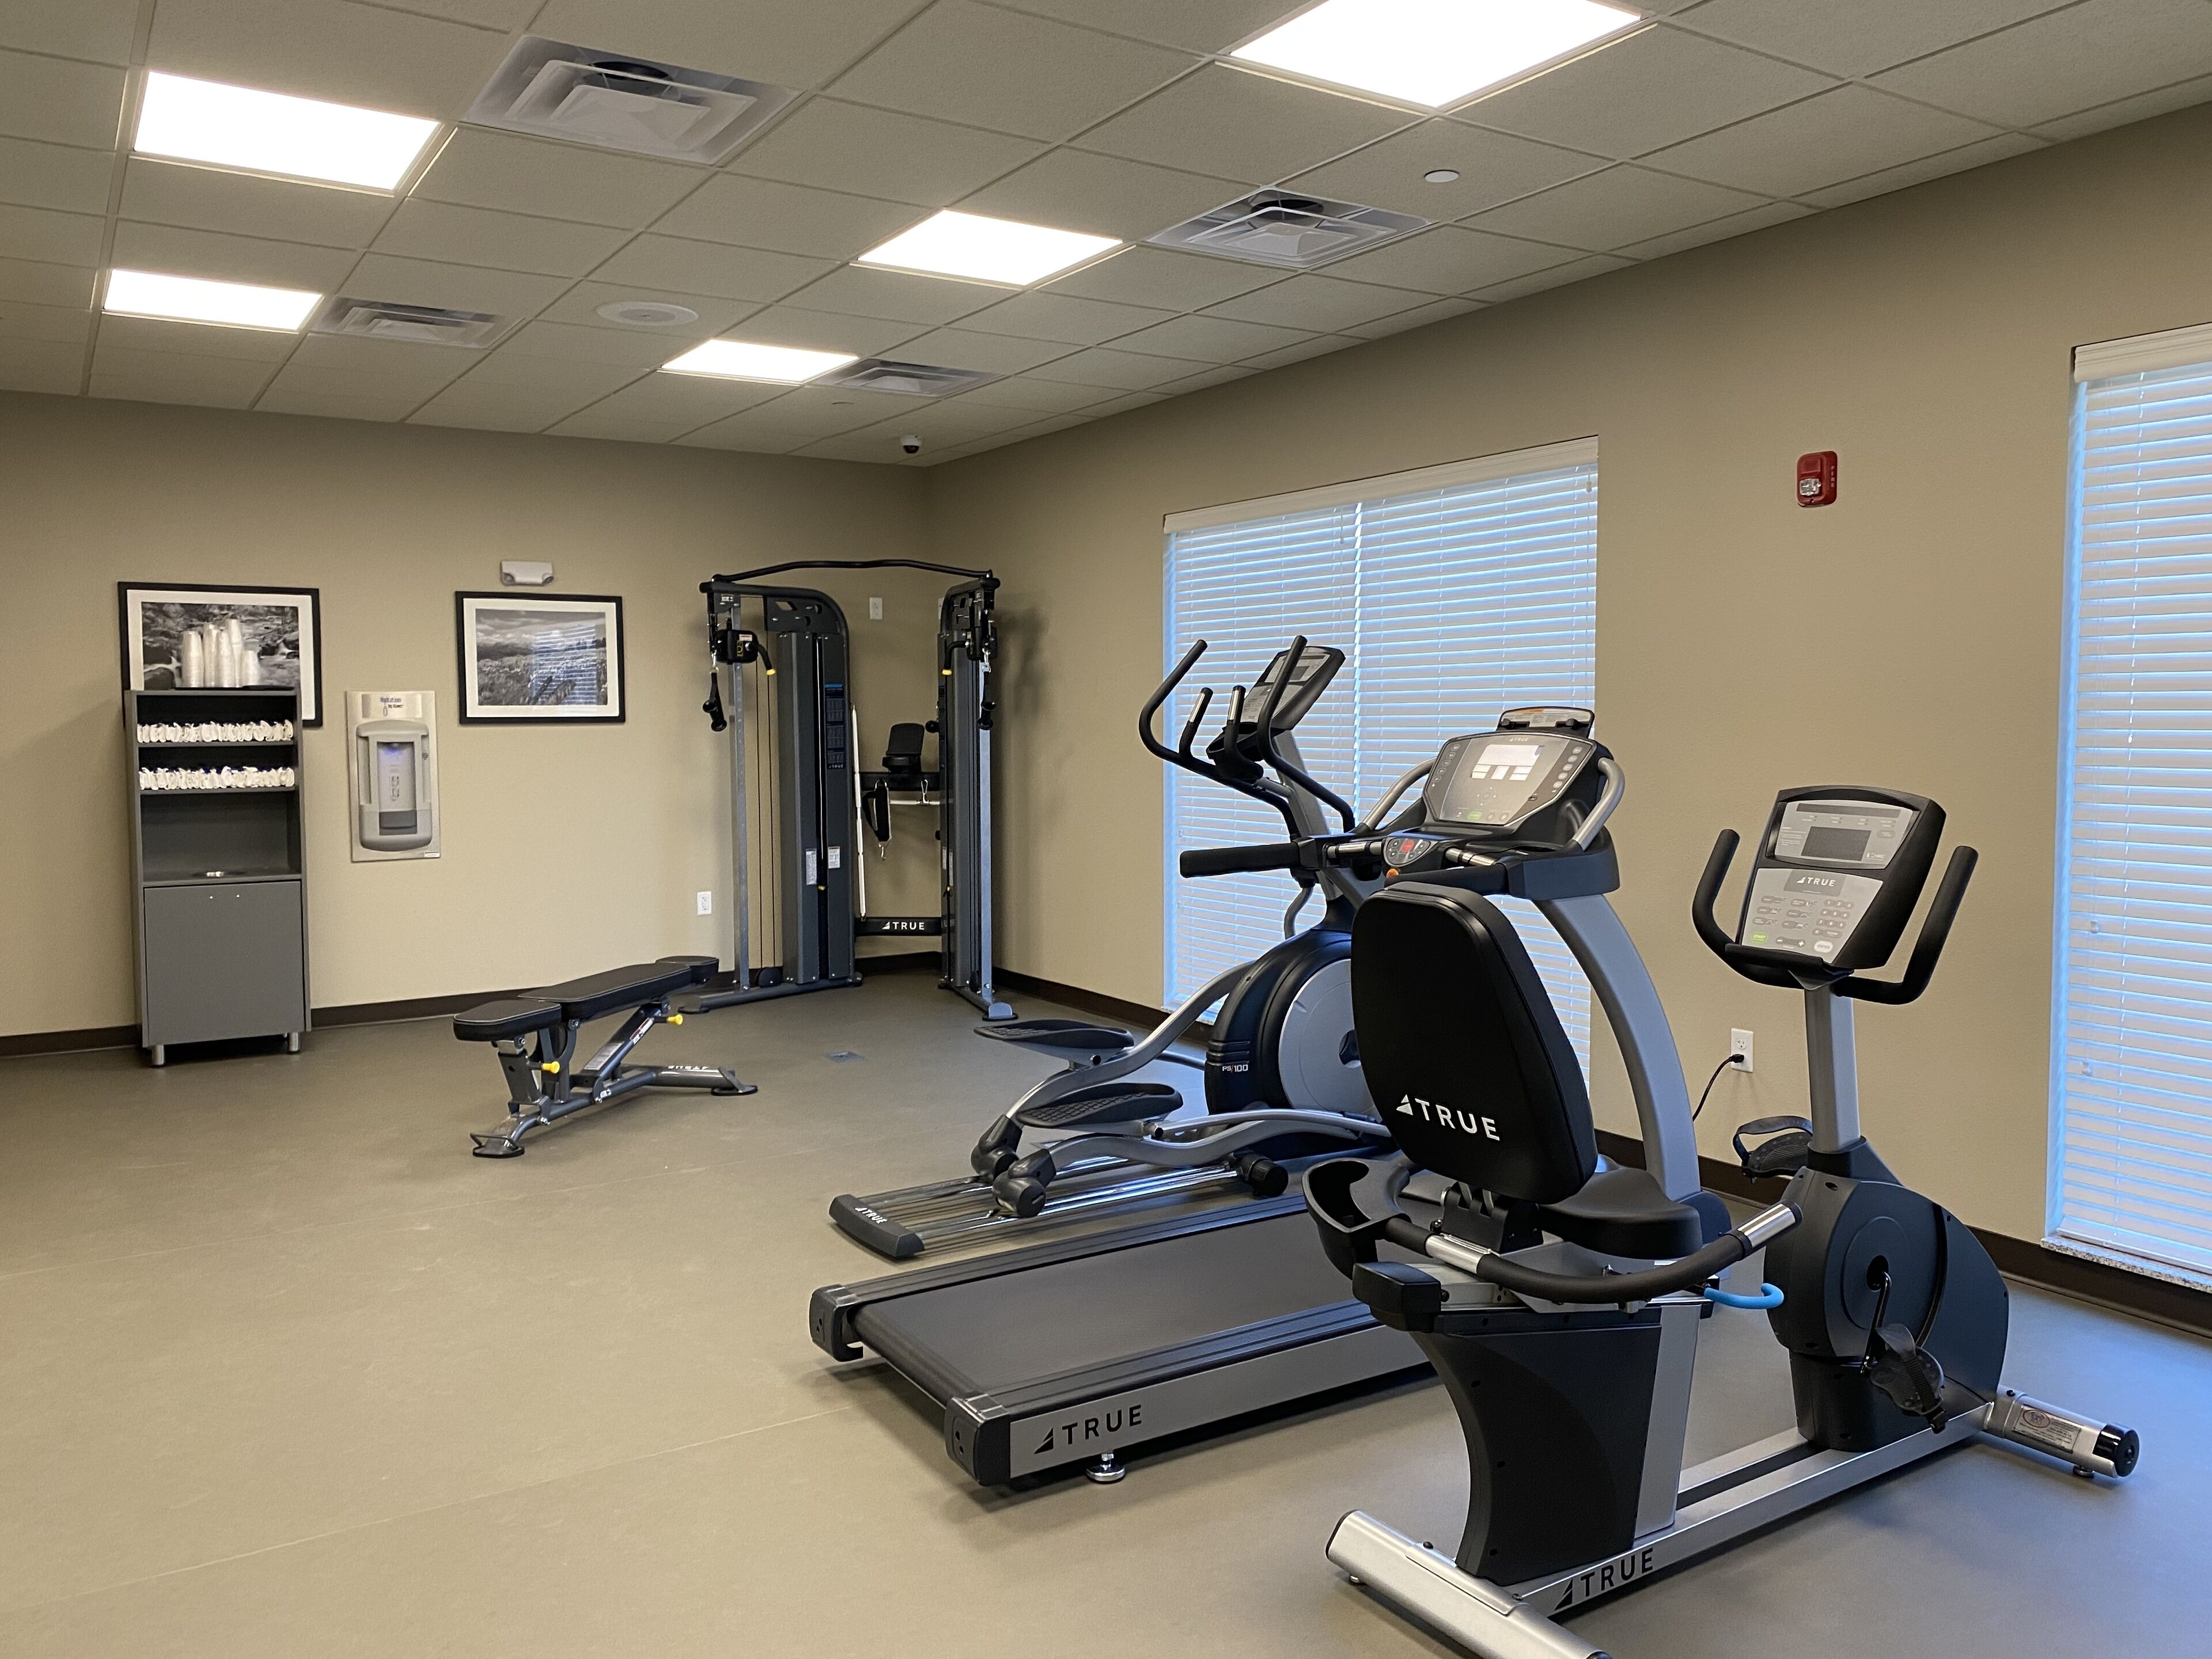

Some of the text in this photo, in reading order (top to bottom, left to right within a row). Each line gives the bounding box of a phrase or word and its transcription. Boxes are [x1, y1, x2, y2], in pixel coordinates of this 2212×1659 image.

[1807, 877, 1836, 887] TRUE
[892, 922, 925, 930] TRUE
[1414, 1098, 1500, 1141] TRUE
[862, 1209, 888, 1224] TRUE
[1062, 1404, 1142, 1445] TRUE
[1580, 1547, 1653, 1597] TRUE
